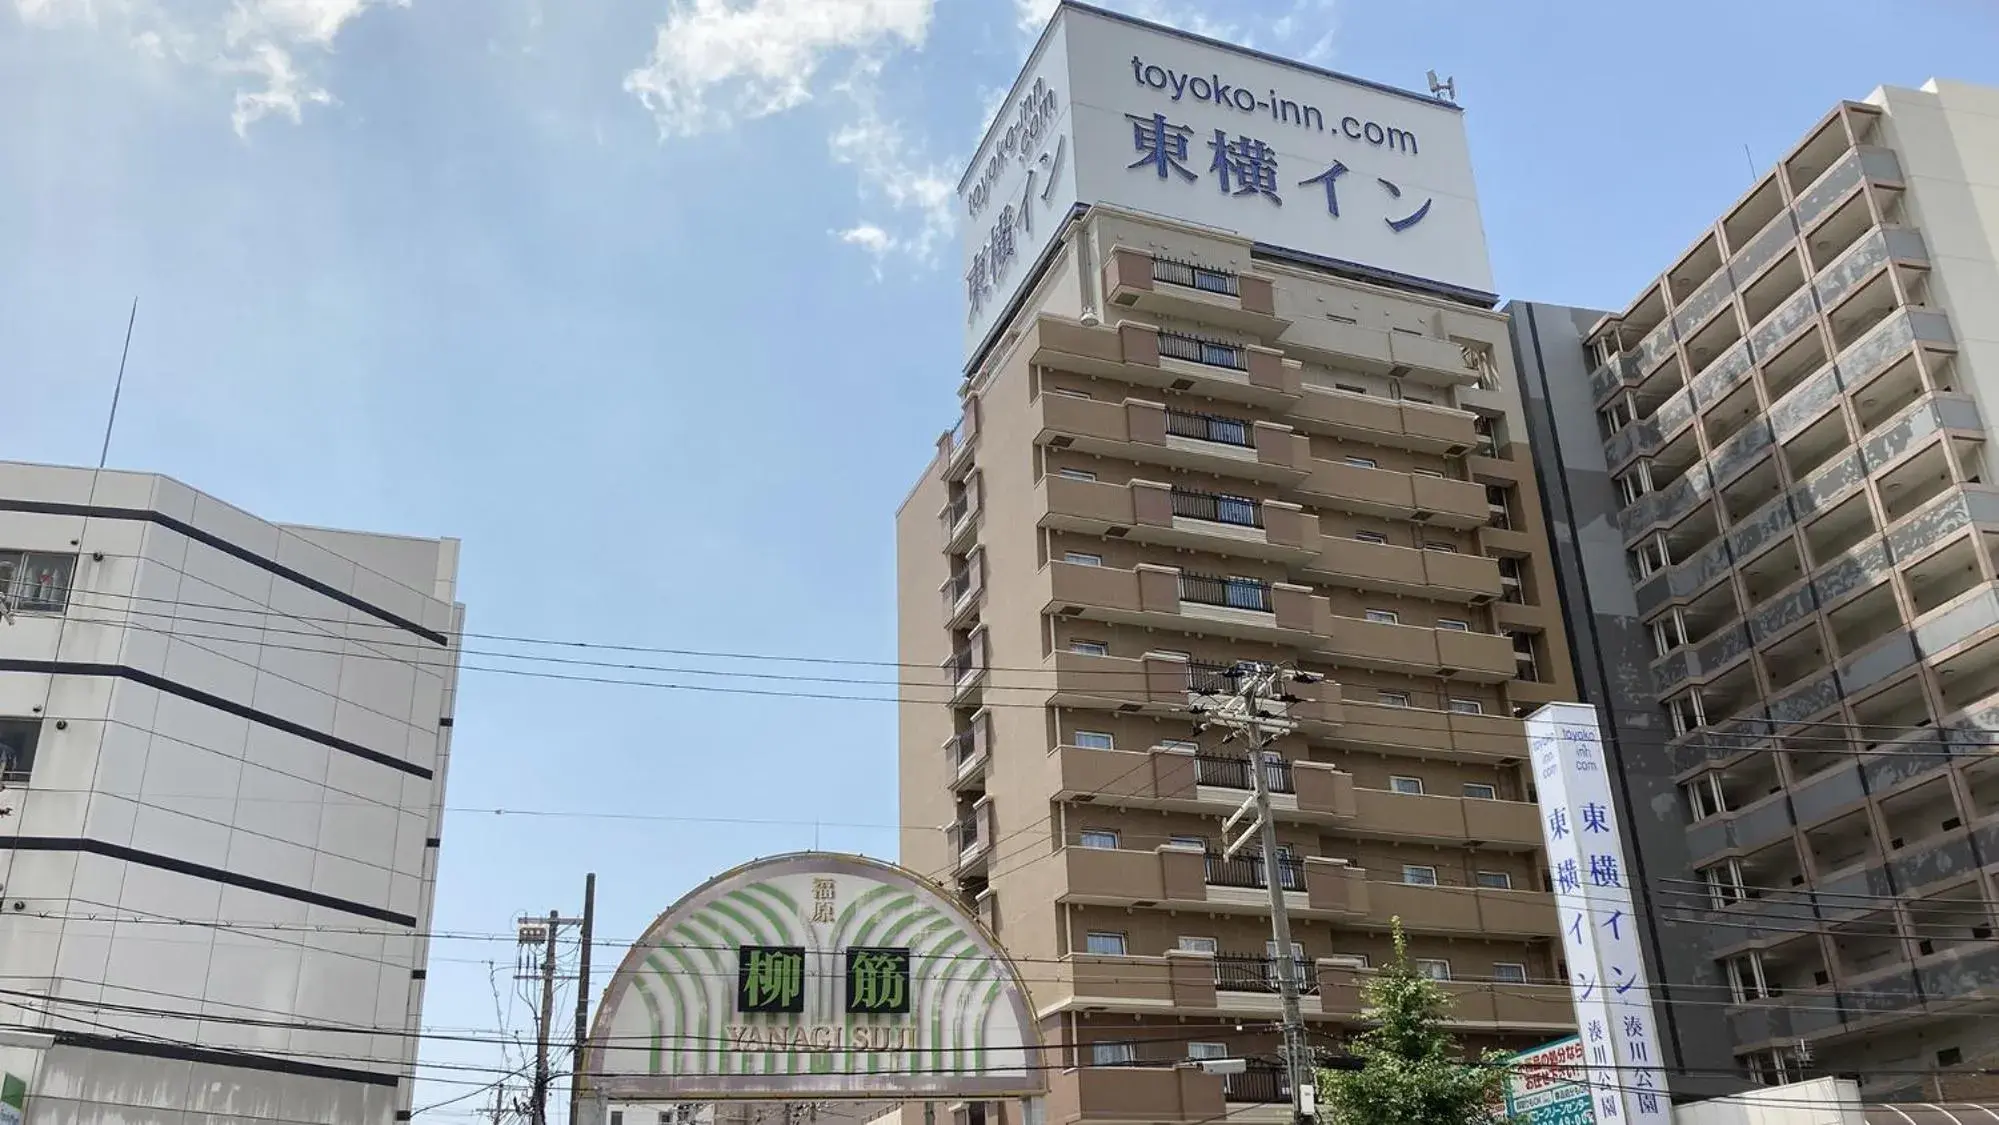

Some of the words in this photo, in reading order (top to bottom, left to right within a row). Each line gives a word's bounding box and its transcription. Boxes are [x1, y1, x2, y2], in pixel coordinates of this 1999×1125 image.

[966, 134, 1066, 319] 東横イン
[1124, 112, 1432, 233] 東横イン
[810, 877, 836, 924] 福原
[1548, 807, 1597, 1000] 東横イン
[1579, 802, 1637, 994] 東横イン
[1623, 1015, 1659, 1114] 湊川公園
[726, 1024, 843, 1051] YANAGI
[853, 1024, 917, 1051] SUJI
